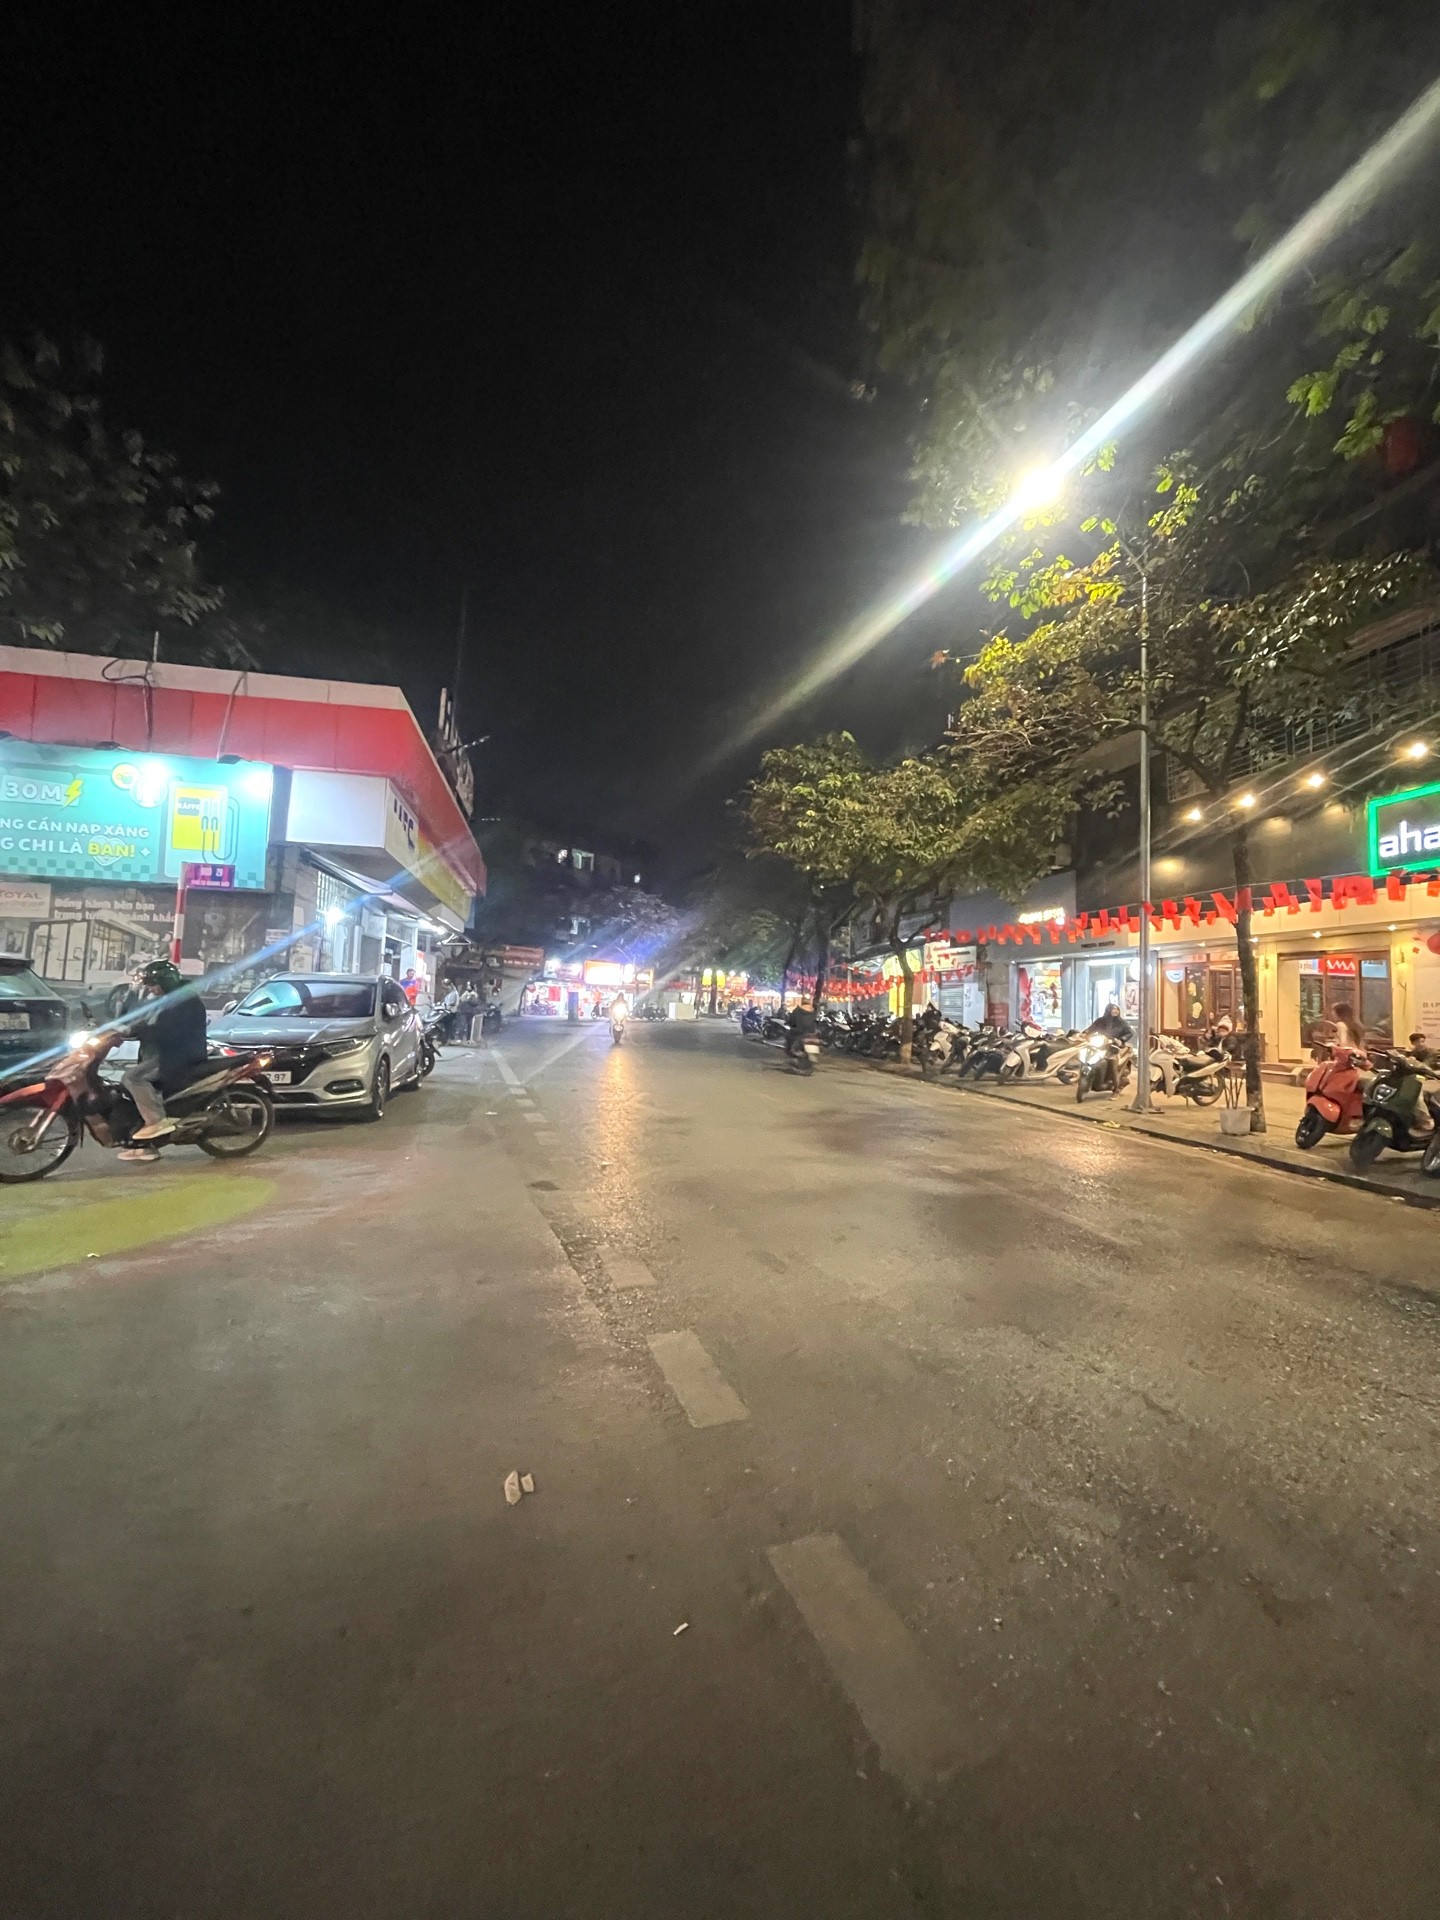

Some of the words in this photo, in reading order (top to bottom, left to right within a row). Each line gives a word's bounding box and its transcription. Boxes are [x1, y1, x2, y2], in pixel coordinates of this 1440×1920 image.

[66, 822, 101, 837] NẠP
[59, 838, 83, 854] LÀ
[1380, 821, 1440, 857] aha
